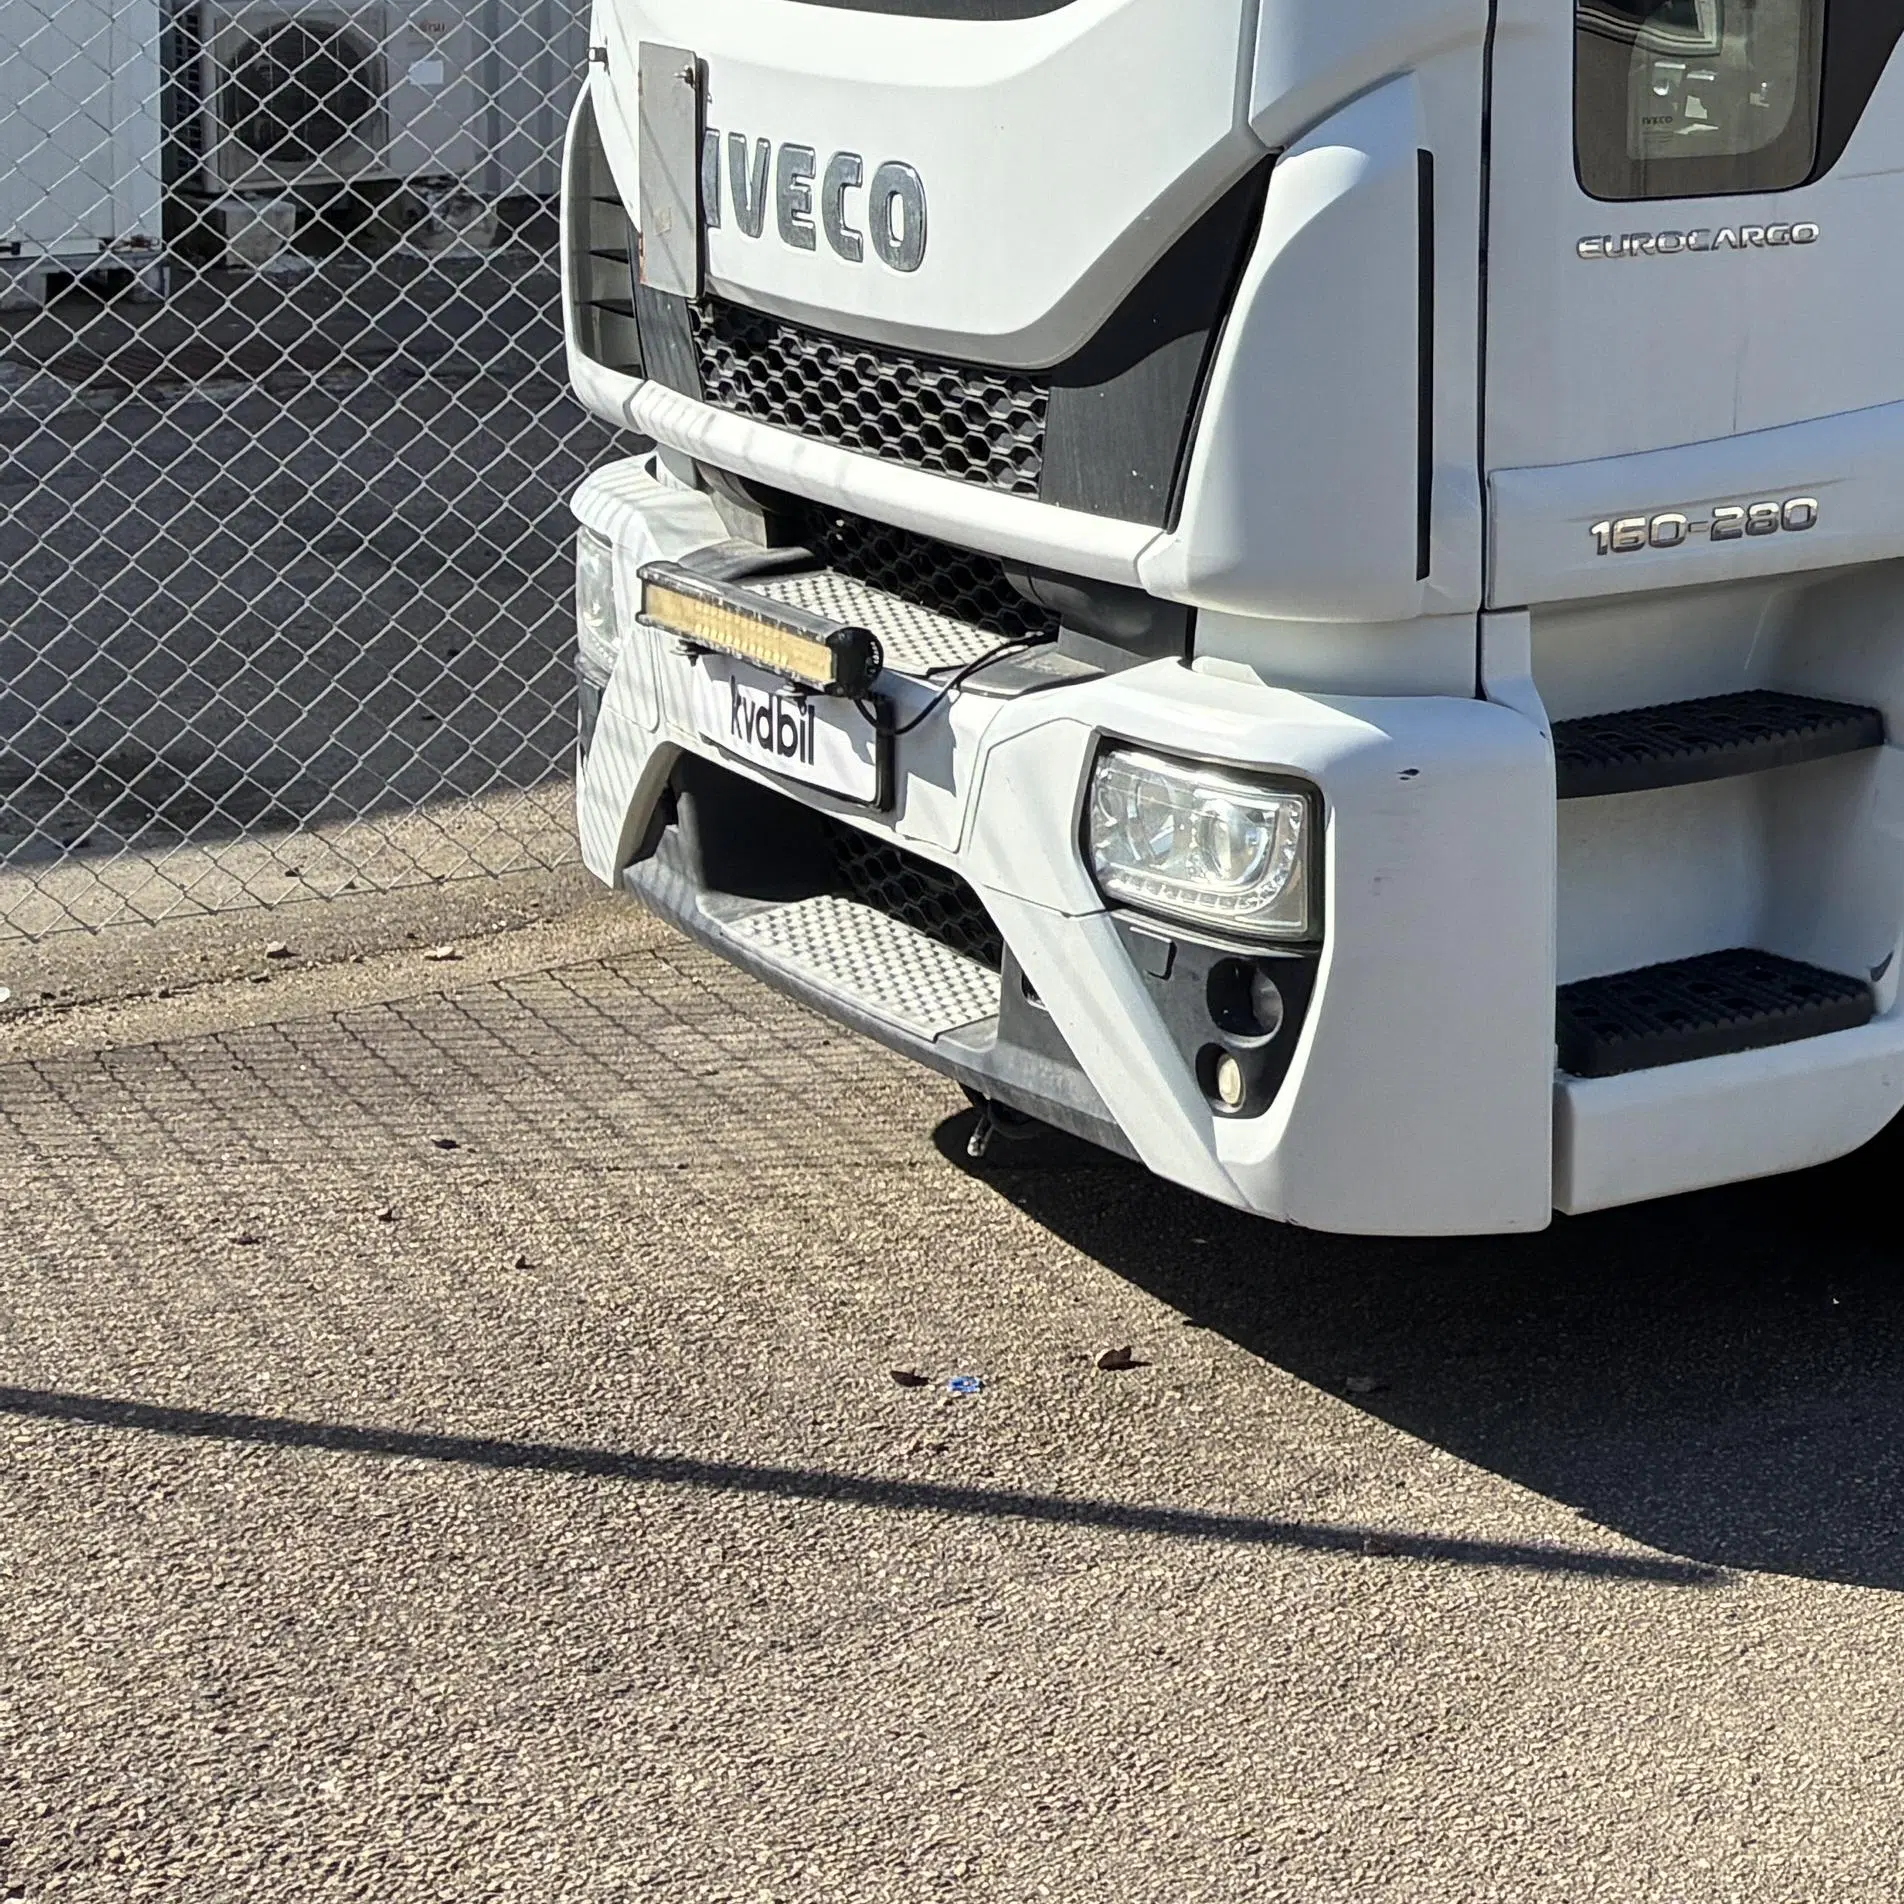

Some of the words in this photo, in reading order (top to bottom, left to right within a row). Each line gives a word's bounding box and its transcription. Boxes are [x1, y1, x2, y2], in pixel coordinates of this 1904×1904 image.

[702, 127, 927, 273] IVECO
[1576, 221, 1820, 259] EUROCARGO
[1588, 497, 1819, 556] 160-280
[730, 674, 816, 766] kvdbil
